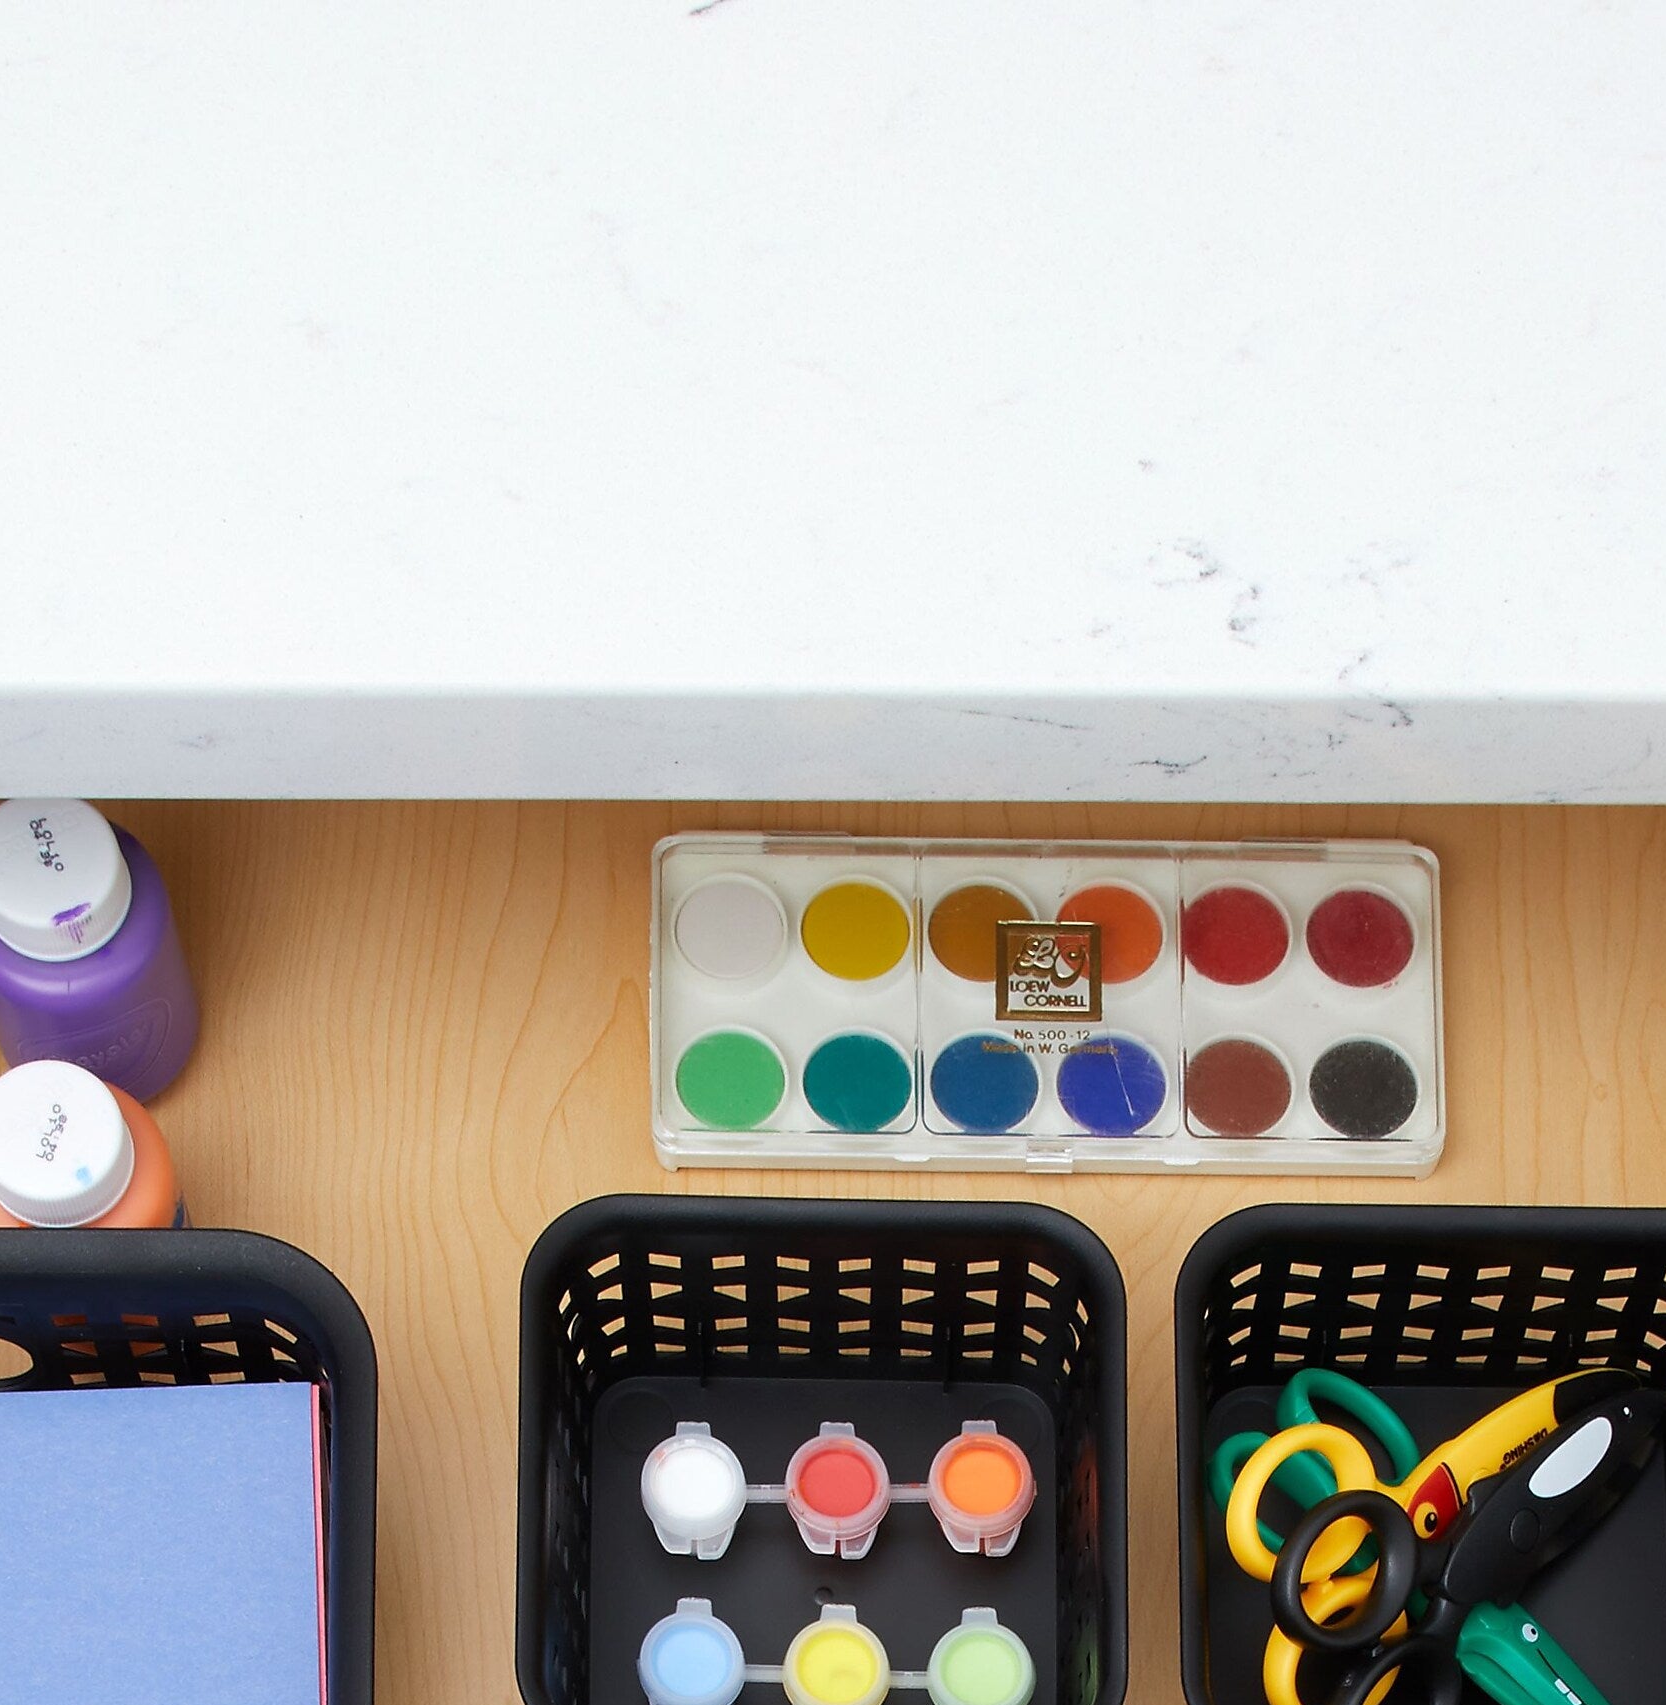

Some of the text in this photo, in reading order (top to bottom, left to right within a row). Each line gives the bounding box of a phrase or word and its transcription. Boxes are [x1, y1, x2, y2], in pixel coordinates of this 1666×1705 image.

[1010, 980, 1050, 993] LOEW
[1024, 995, 1087, 1008] CORNELL
[1024, 1042, 1035, 1053] in
[1039, 1043, 1055, 1054] W.
